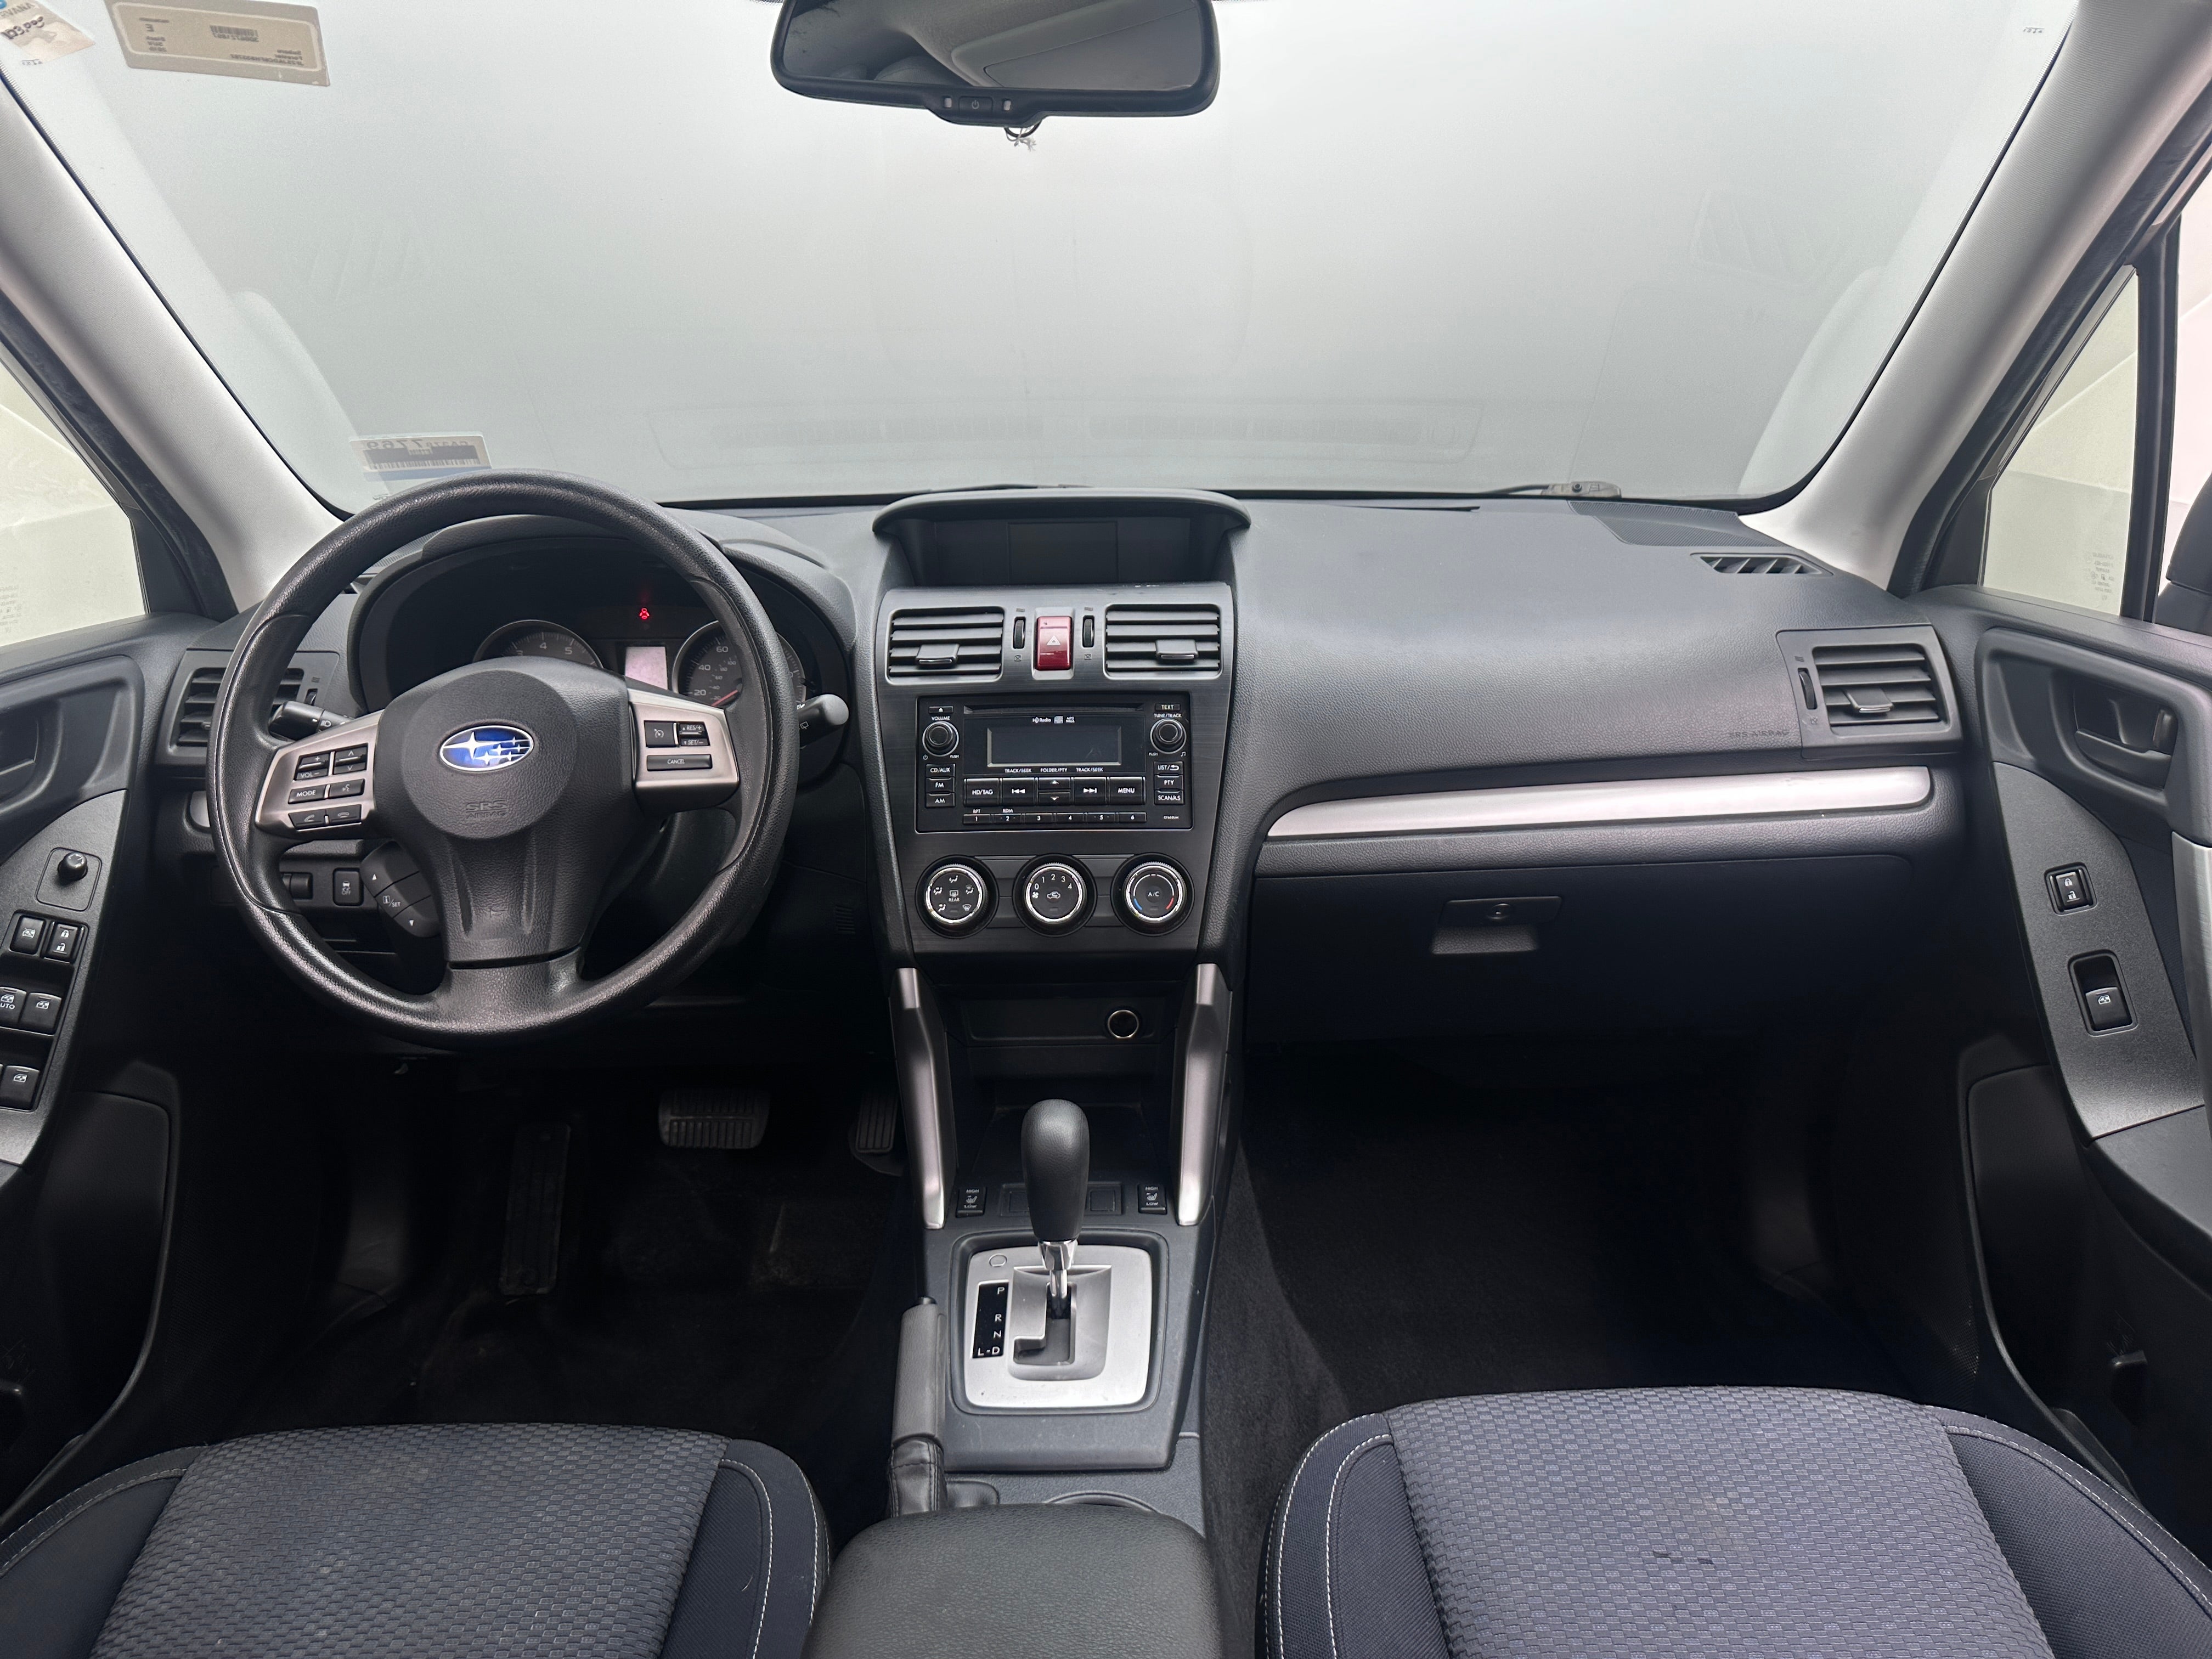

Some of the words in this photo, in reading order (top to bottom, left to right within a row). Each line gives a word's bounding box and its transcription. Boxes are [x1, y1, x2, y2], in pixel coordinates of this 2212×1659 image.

[466, 799, 507, 811] SRS
[995, 1313, 1002, 1322] R
[993, 1330, 1002, 1339] N
